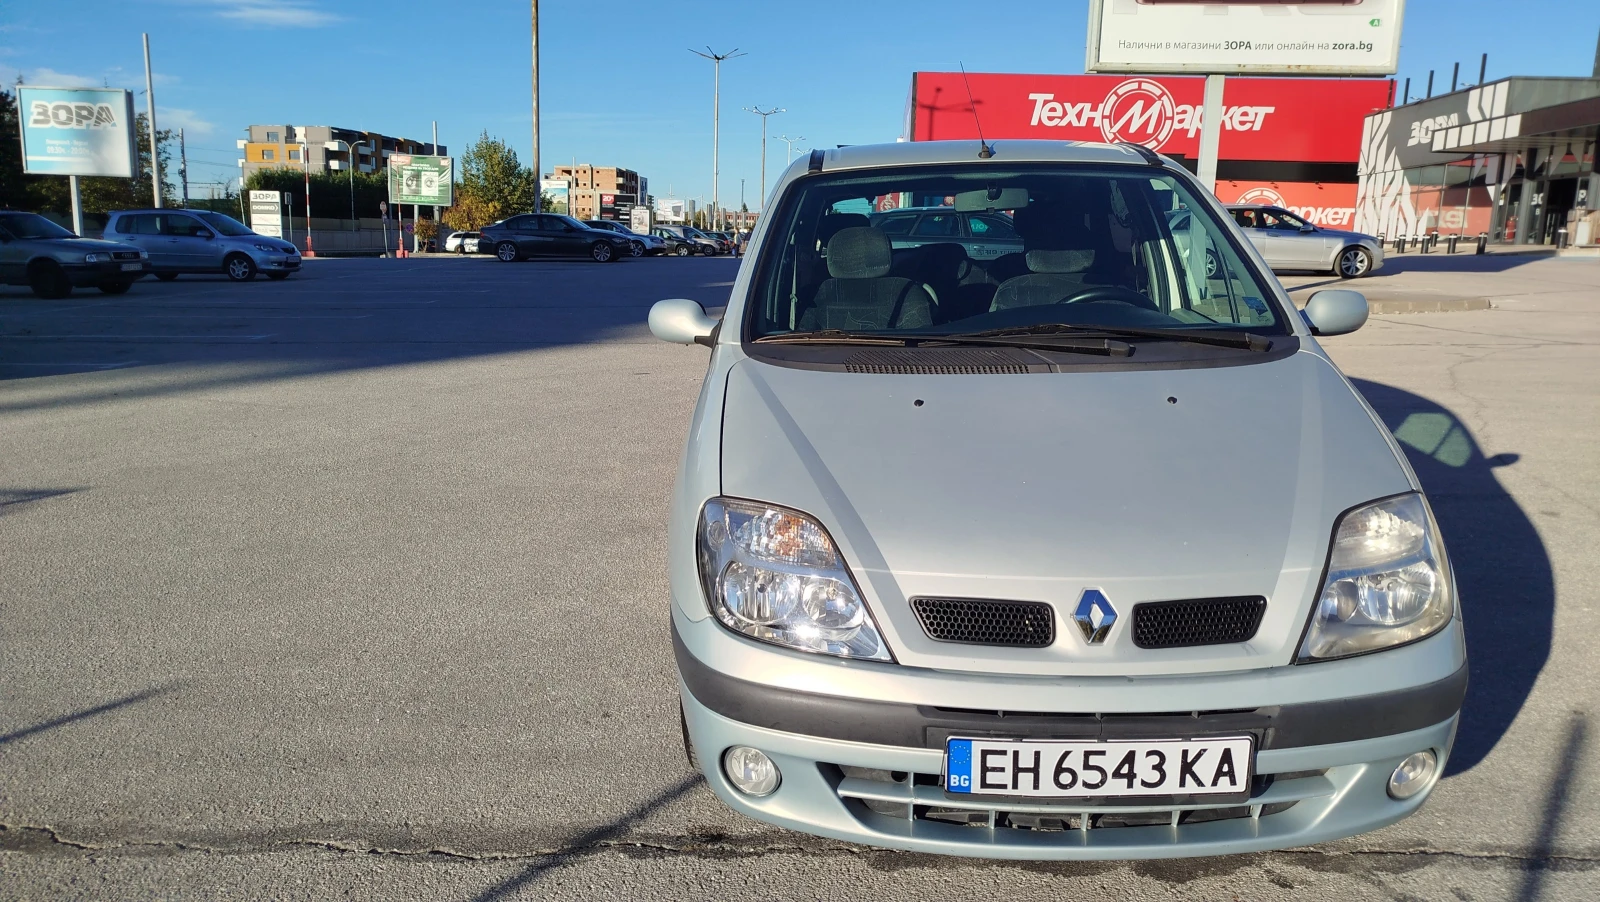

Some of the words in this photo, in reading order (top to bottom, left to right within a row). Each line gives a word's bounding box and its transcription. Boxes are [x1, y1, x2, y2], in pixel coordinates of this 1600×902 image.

[1118, 39, 1163, 50] Налични
[1165, 42, 1171, 50] в
[1173, 42, 1221, 51] магазини
[1224, 41, 1252, 51] ЗОРА
[1255, 42, 1274, 51] или
[1277, 41, 1315, 51] онлайн
[1317, 43, 1330, 51] на
[1332, 41, 1373, 52] zora.bg
[30, 101, 117, 129] ЗОРА
[979, 749, 1041, 791] EH
[1052, 749, 1167, 790] 6543
[1178, 747, 1238, 788] KA
[950, 774, 970, 787] BG
